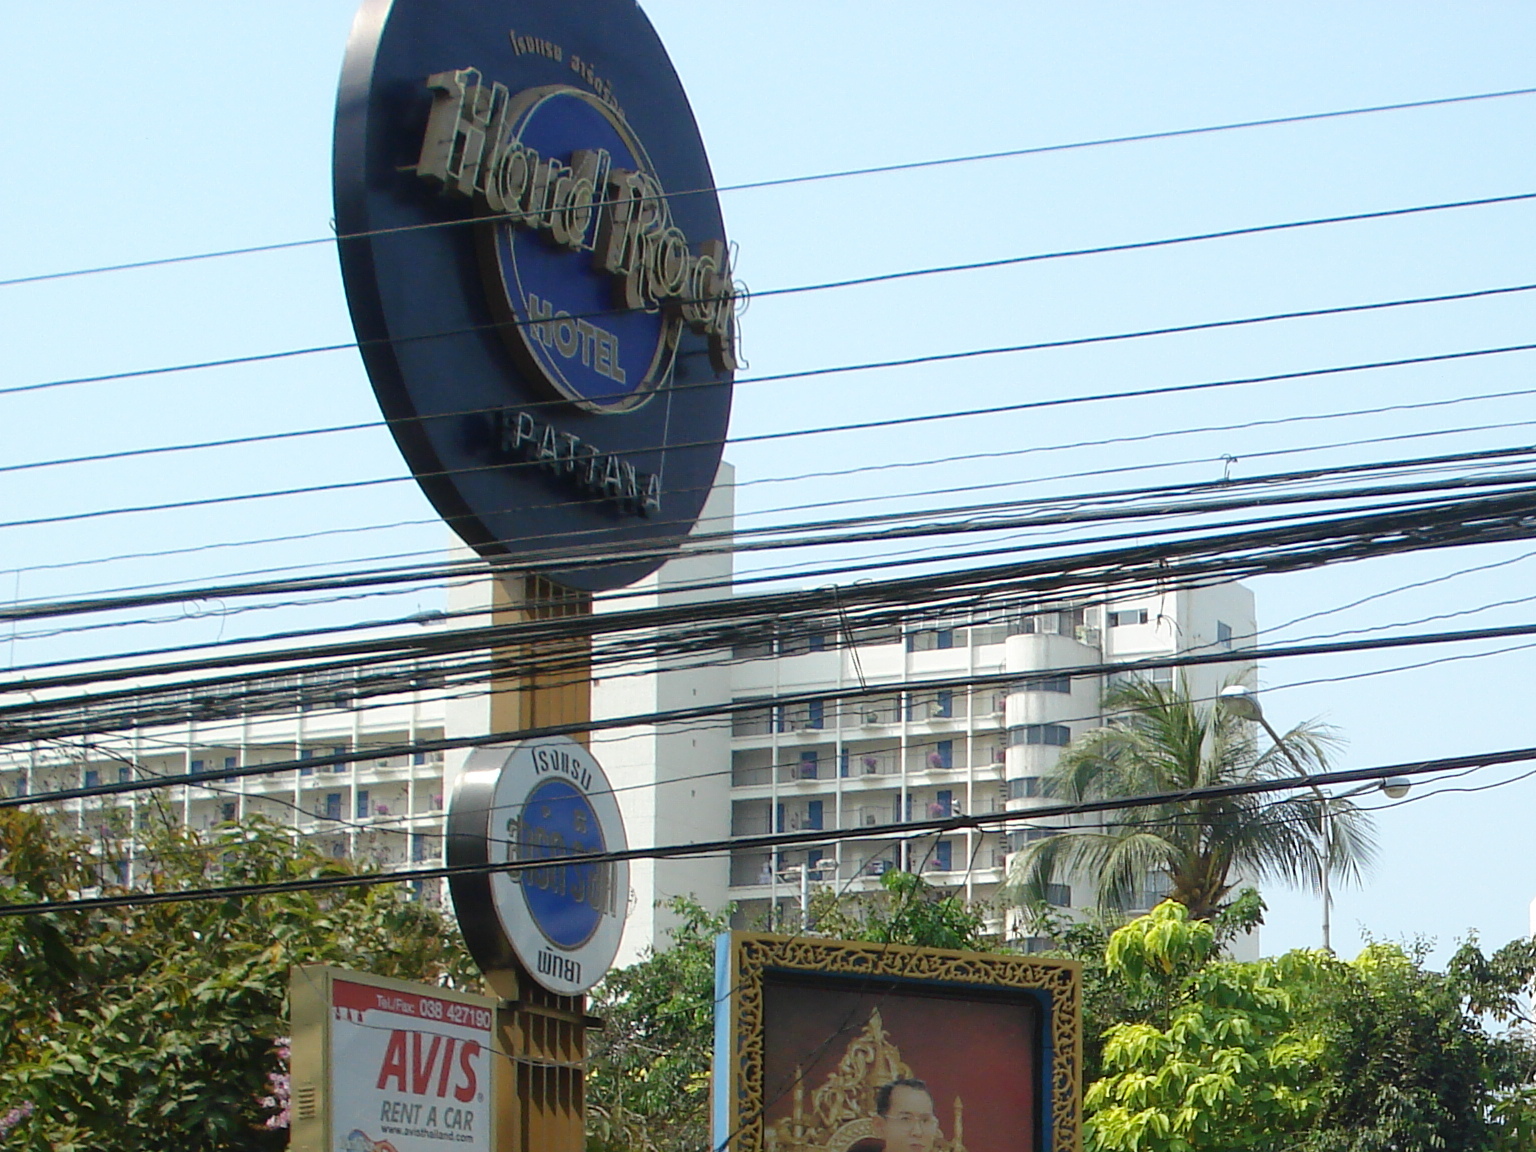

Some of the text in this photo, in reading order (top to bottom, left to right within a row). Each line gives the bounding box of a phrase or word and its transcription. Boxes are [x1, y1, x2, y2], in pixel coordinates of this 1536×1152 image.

[417, 66, 750, 371] Hard Rock
[529, 293, 626, 384] HOTEL
[511, 411, 661, 512] PATTAYA
[531, 746, 592, 791] โรงแรม
[538, 945, 581, 984] พัทยา
[419, 999, 443, 1019] 038
[446, 1005, 491, 1029] 427190
[376, 1029, 481, 1103] AVIS
[380, 1100, 474, 1131] RENT A CAR
[381, 1125, 474, 1143] www.avisthailand.com
